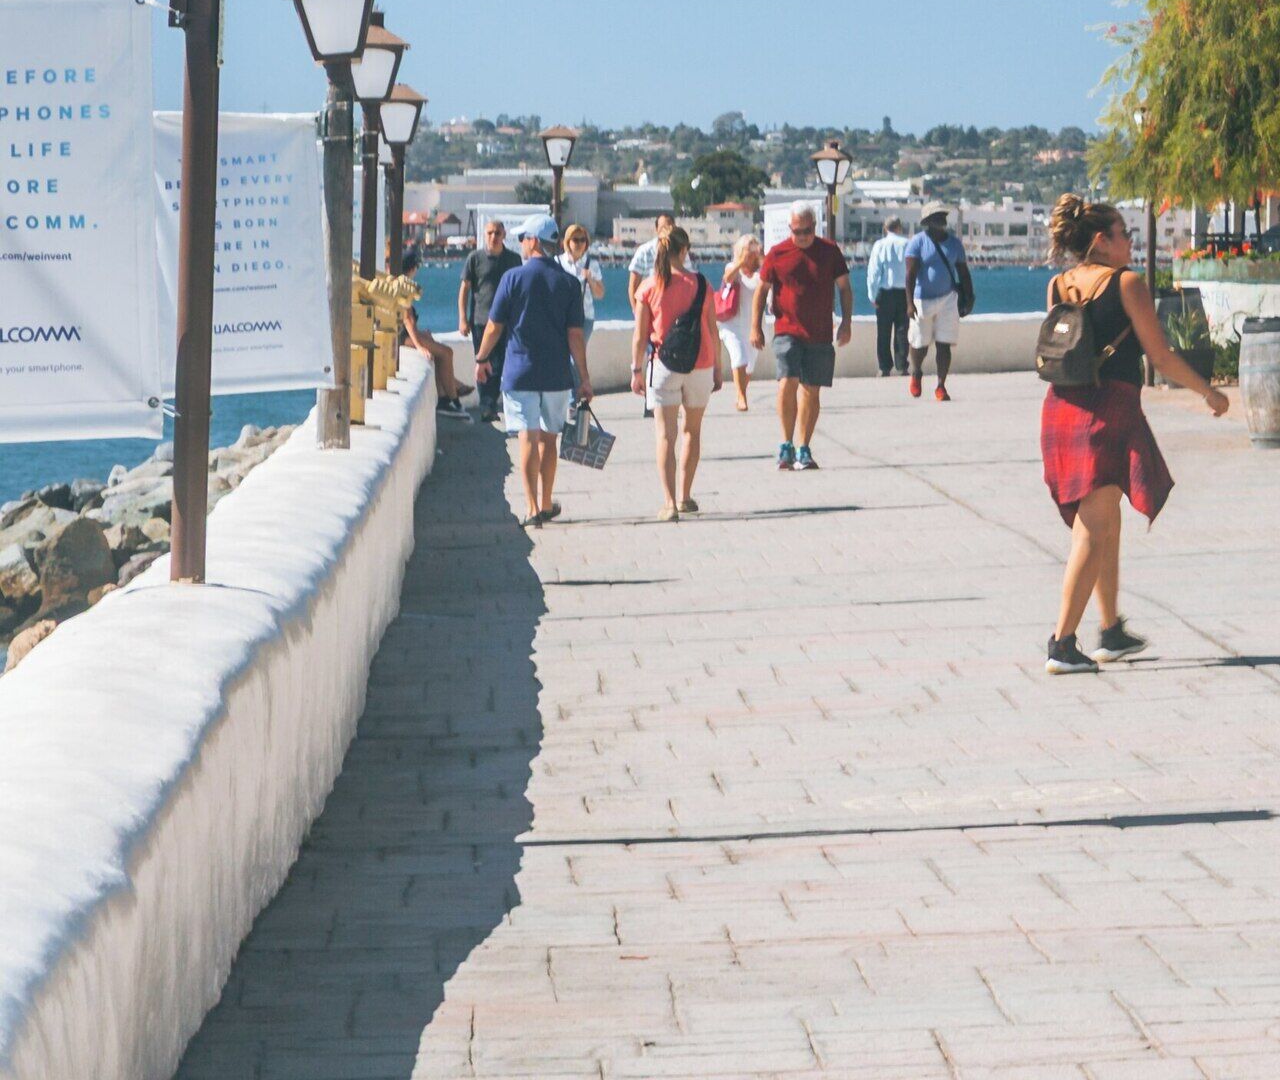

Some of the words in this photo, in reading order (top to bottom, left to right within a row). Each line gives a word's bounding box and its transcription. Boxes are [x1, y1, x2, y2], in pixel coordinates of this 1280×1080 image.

[10, 142, 71, 157] LIFE
[220, 154, 277, 166] SMART
[240, 174, 292, 185] EVERY
[233, 218, 277, 229] BORN
[253, 239, 269, 249] IN
[232, 260, 291, 273] DIEGO.
[213, 320, 281, 334] UALCOMM
[5, 366, 25, 375] your
[28, 363, 84, 373] smartphone.
